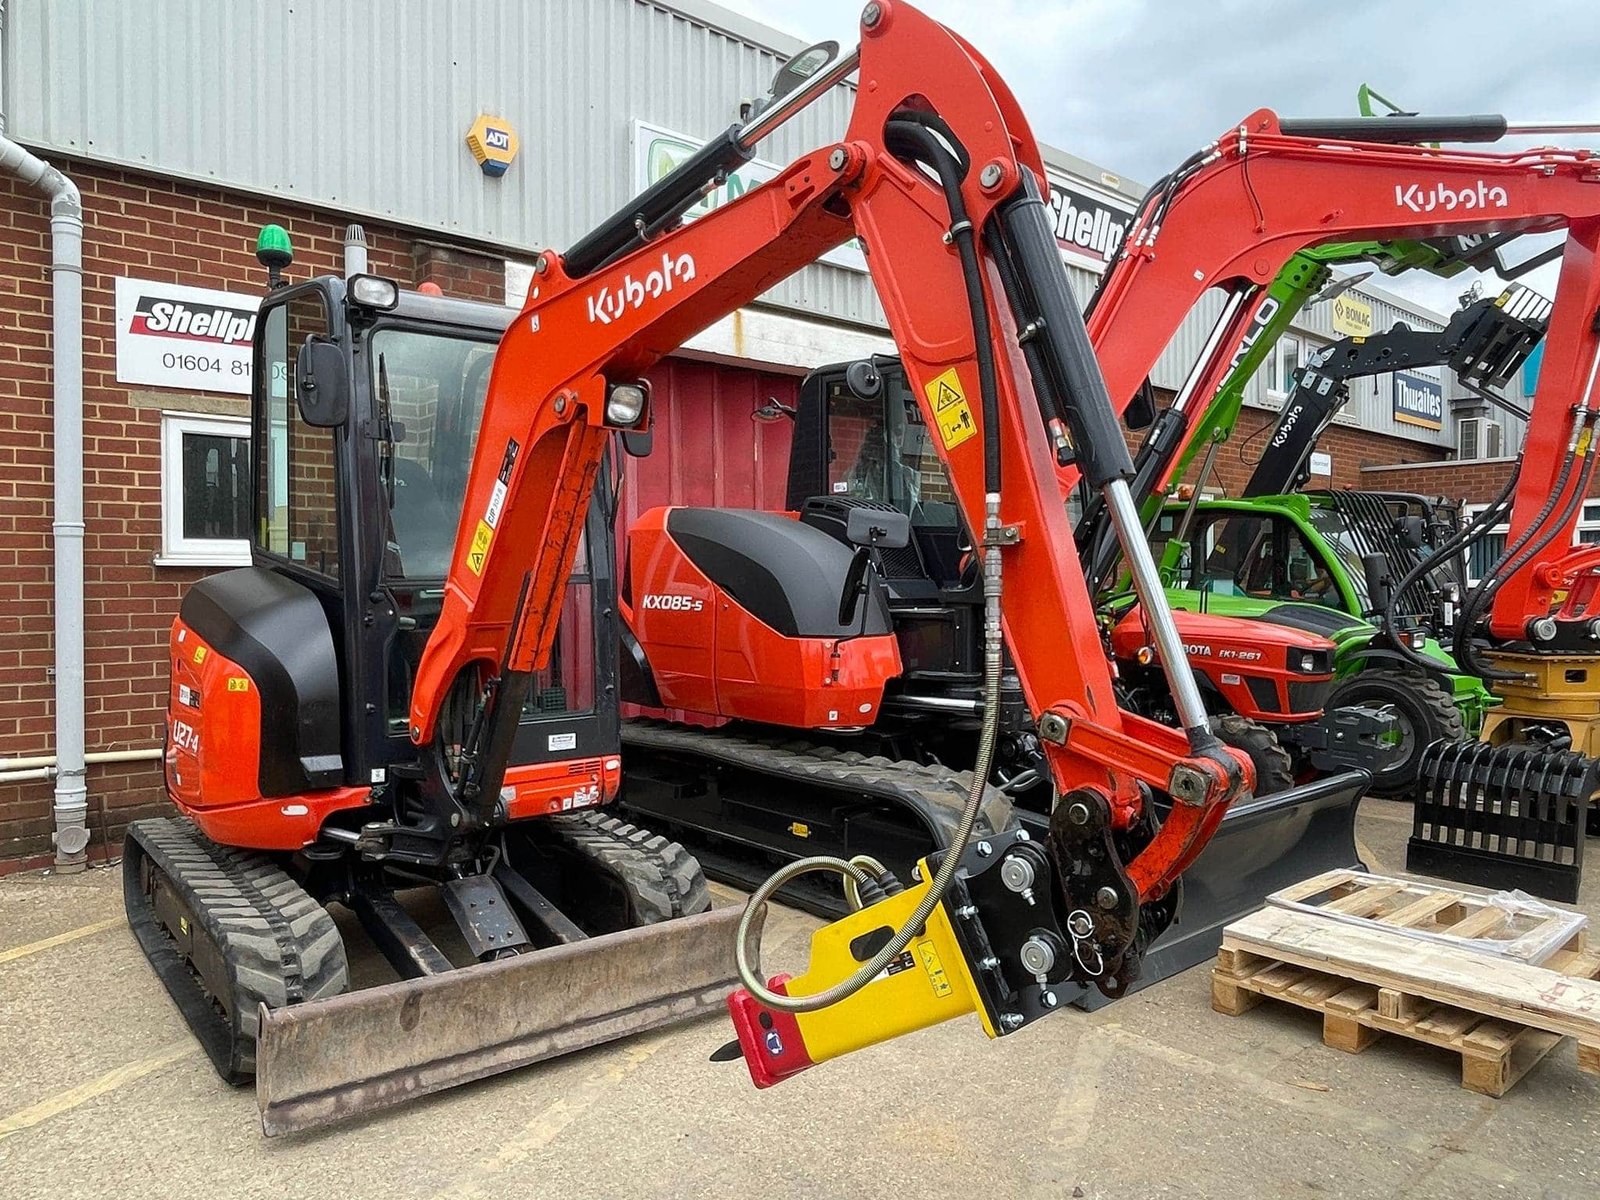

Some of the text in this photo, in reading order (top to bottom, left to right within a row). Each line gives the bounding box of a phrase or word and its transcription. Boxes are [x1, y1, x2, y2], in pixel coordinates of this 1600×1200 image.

[486, 131, 509, 148] ADT
[1395, 180, 1508, 212] Kubota
[1046, 189, 1131, 261] Shellp
[587, 252, 696, 325] Kubota
[163, 353, 222, 373] 01604
[231, 360, 253, 376] 81
[1397, 379, 1441, 417] Thwaites
[1272, 405, 1303, 448] Kubota
[173, 720, 199, 753] U27-4
